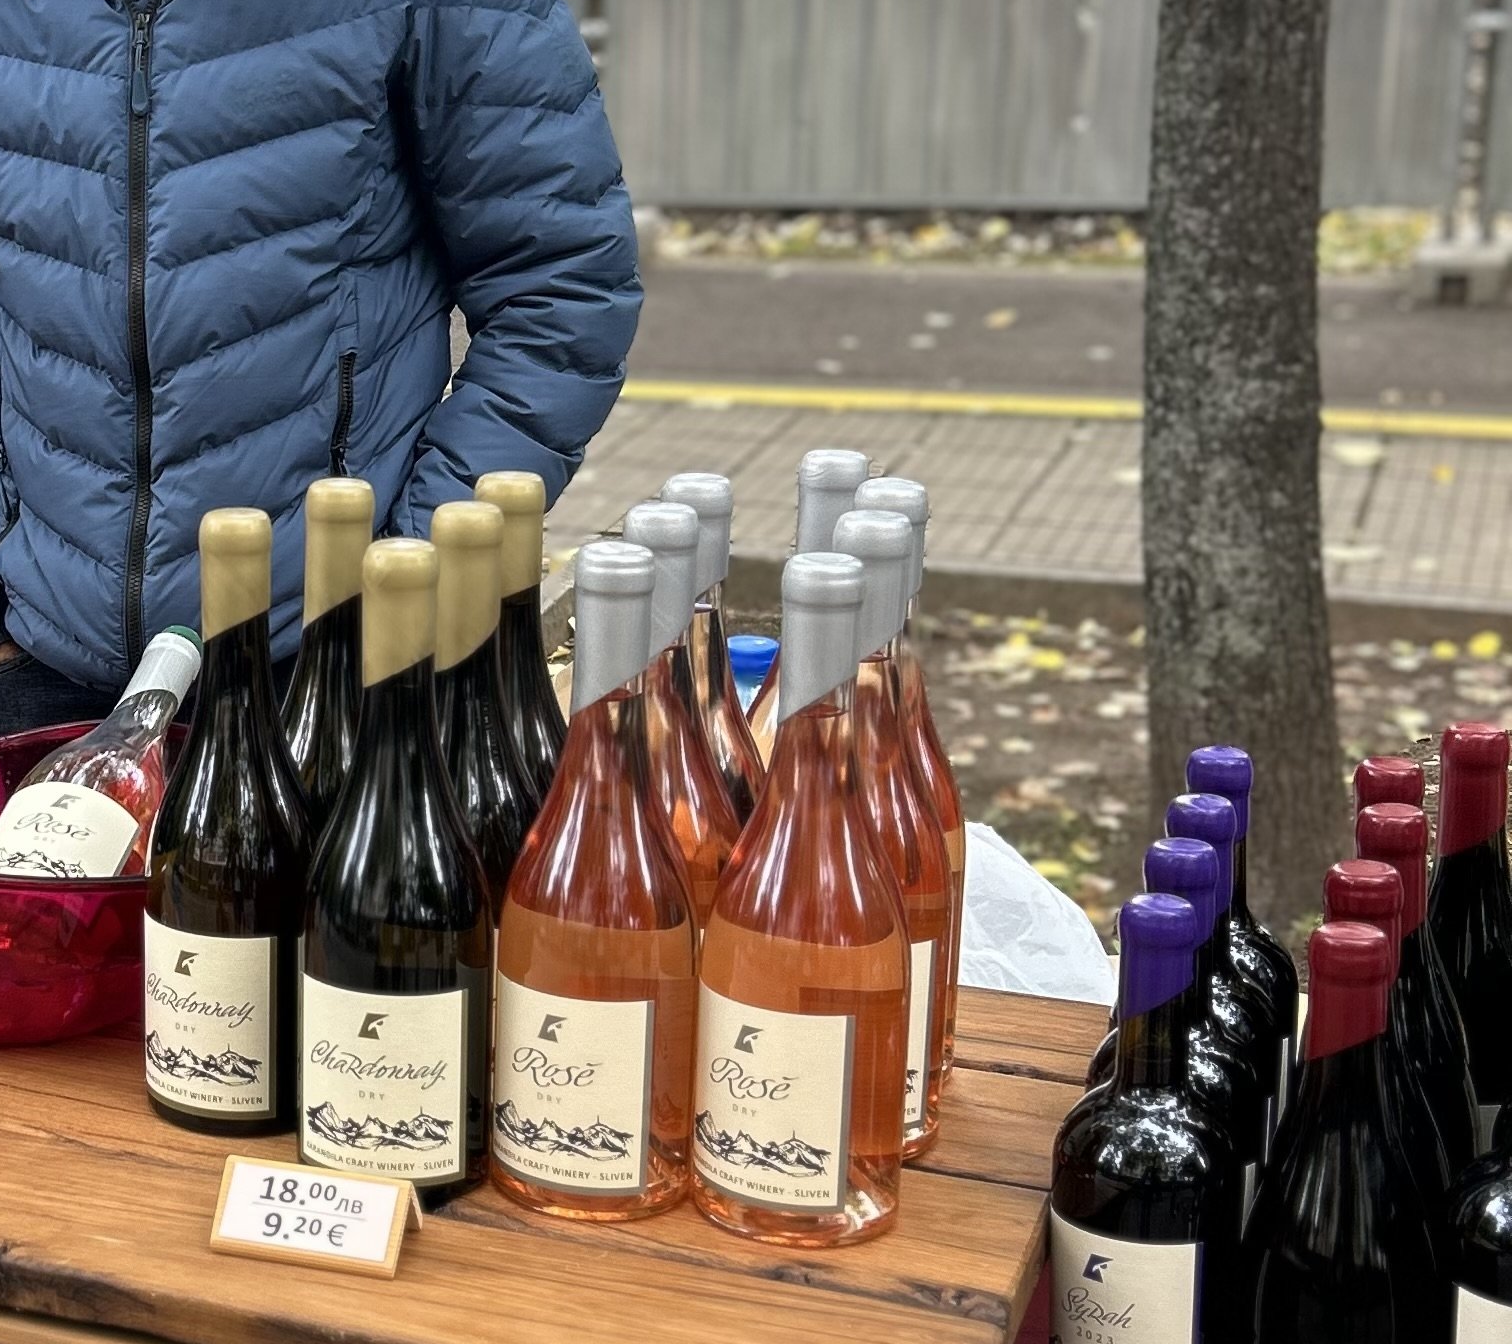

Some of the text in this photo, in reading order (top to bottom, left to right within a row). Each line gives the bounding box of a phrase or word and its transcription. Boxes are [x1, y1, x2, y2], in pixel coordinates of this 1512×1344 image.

[190, 1092, 223, 1104] WINERY
[358, 1090, 385, 1101] DRY
[732, 1103, 758, 1118] DRY
[345, 1158, 374, 1169] CRAFT
[376, 1162, 415, 1171] WINERY
[423, 1158, 454, 1169] SLIVEN
[523, 1158, 550, 1173] CRAFT
[551, 1166, 591, 1180] WINERY
[599, 1172, 633, 1181] SLIVEN
[719, 1170, 745, 1187] CRAFT
[745, 1179, 785, 1196] WINERY
[794, 1189, 830, 1199] SLIVEN
